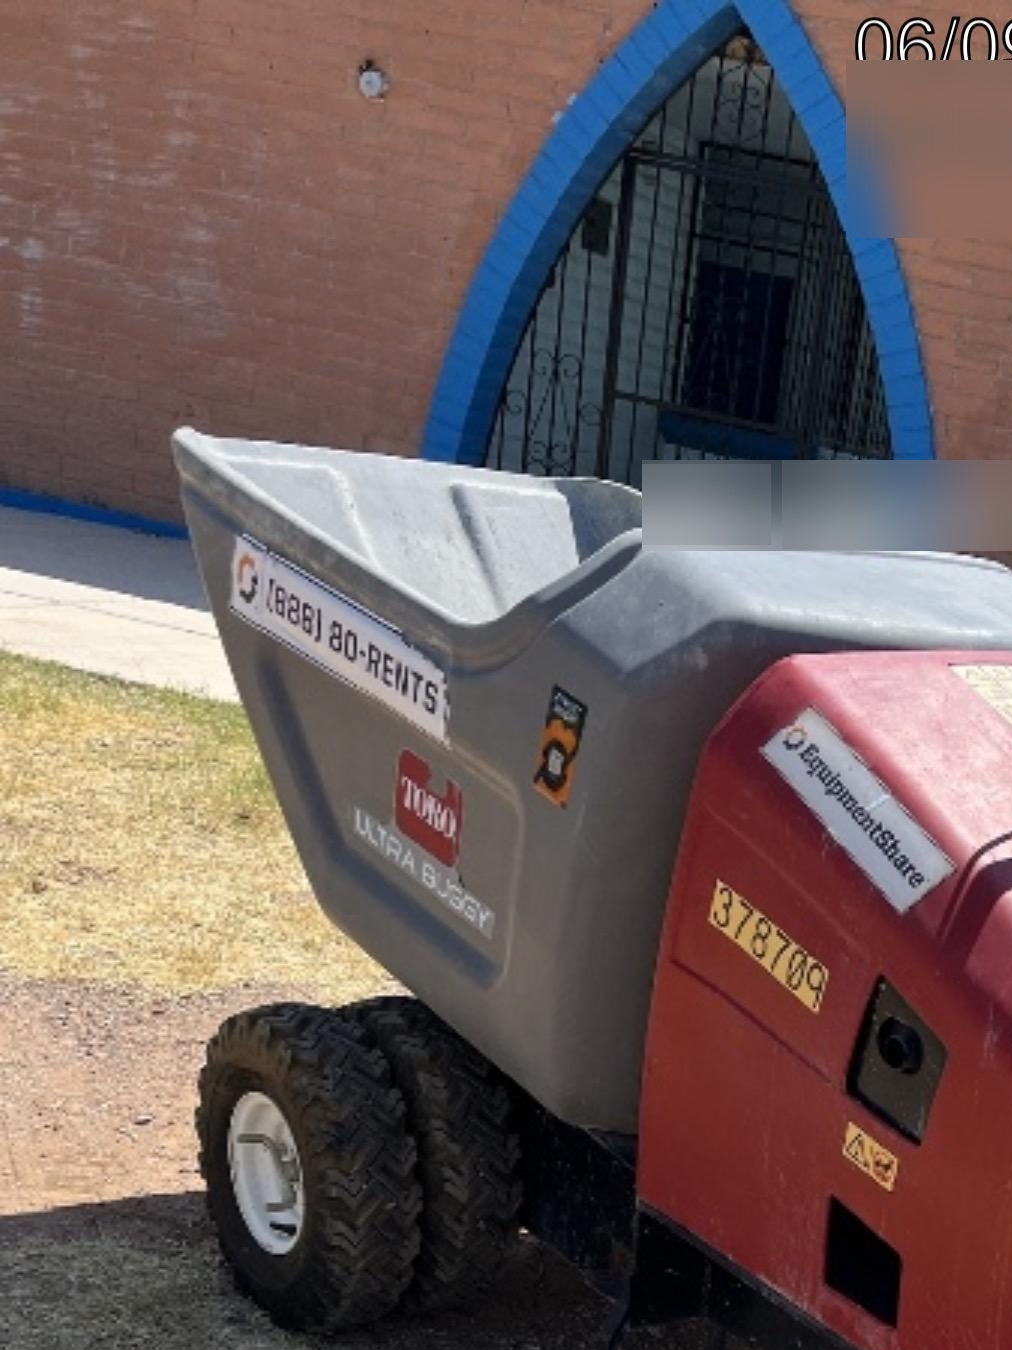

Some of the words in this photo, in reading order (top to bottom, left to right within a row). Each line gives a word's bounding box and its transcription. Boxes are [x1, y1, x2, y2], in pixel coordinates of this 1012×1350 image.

[328, 620, 439, 715] 80-RENTS
[354, 806, 416, 873] ULTRA
[421, 861, 492, 929] BUGGY
[401, 775, 459, 839] TORO
[798, 743, 926, 888] EquipmentShare
[713, 886, 825, 1009] 378709
